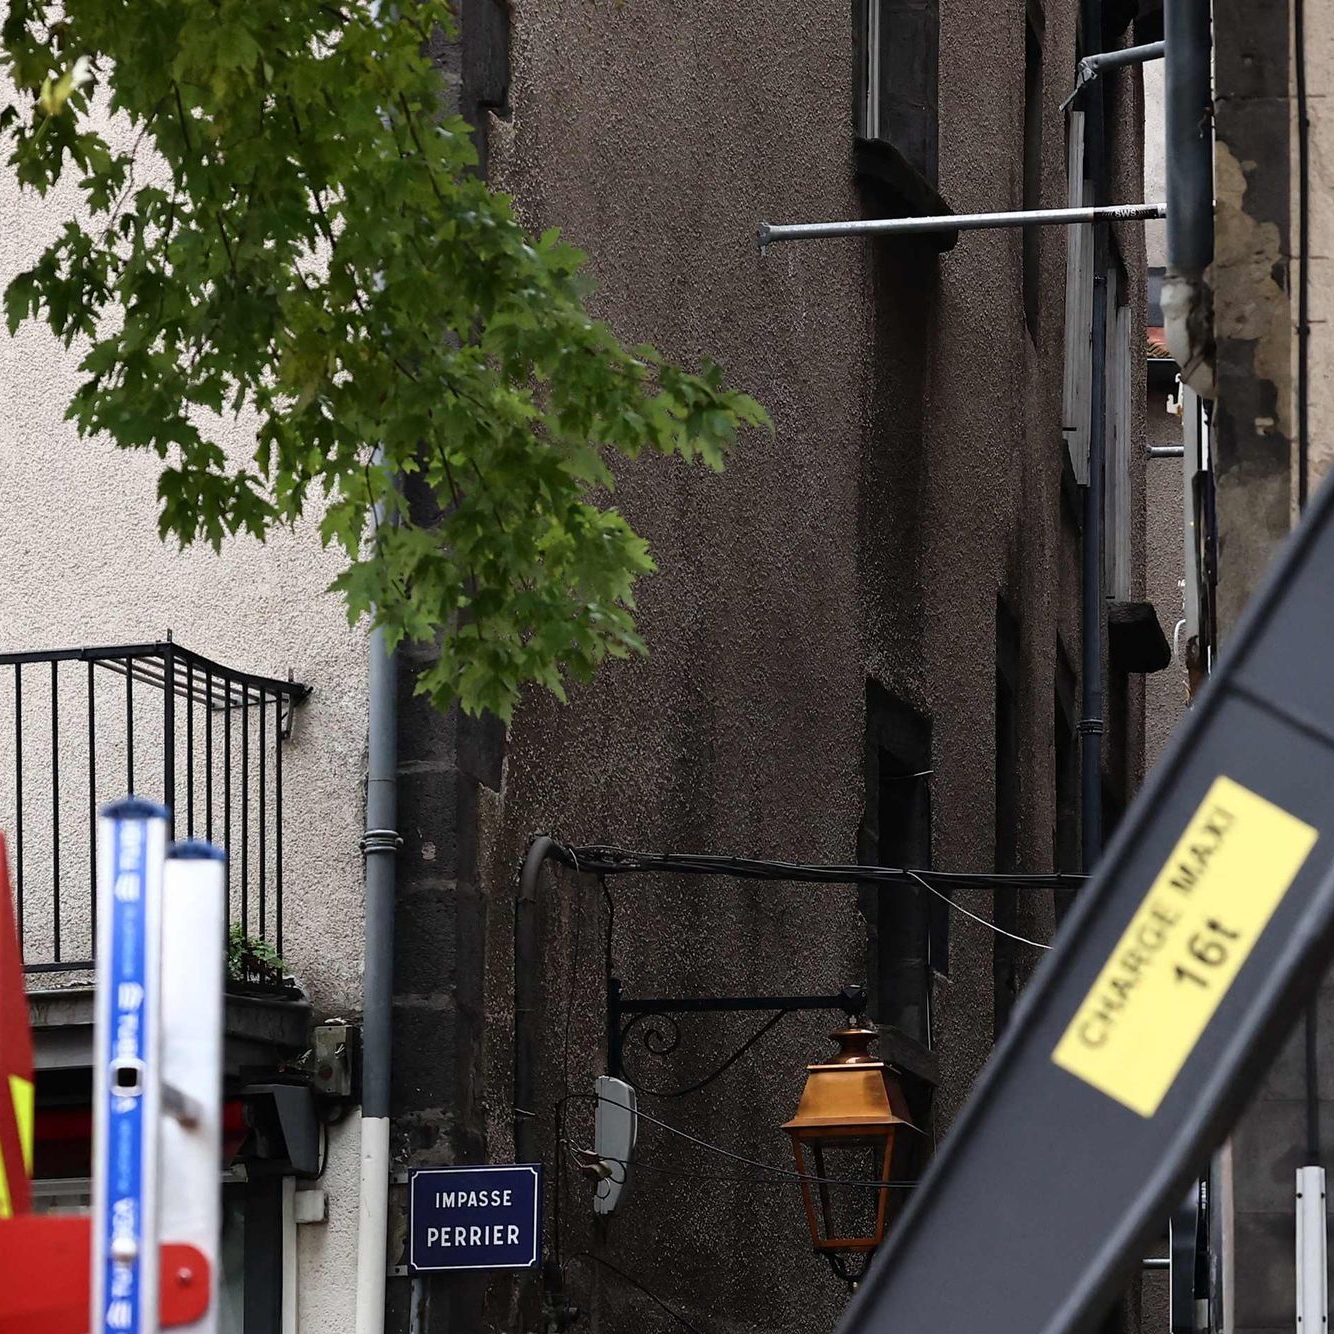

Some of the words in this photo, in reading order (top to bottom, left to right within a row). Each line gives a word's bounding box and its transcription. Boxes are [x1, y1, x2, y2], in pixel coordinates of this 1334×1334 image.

[1079, 903, 1181, 1048] CHARGE
[1170, 807, 1235, 894] MAXI
[1173, 919, 1242, 990] 16t
[435, 1189, 512, 1209] IMPASSE
[427, 1224, 520, 1248] PERRIER
